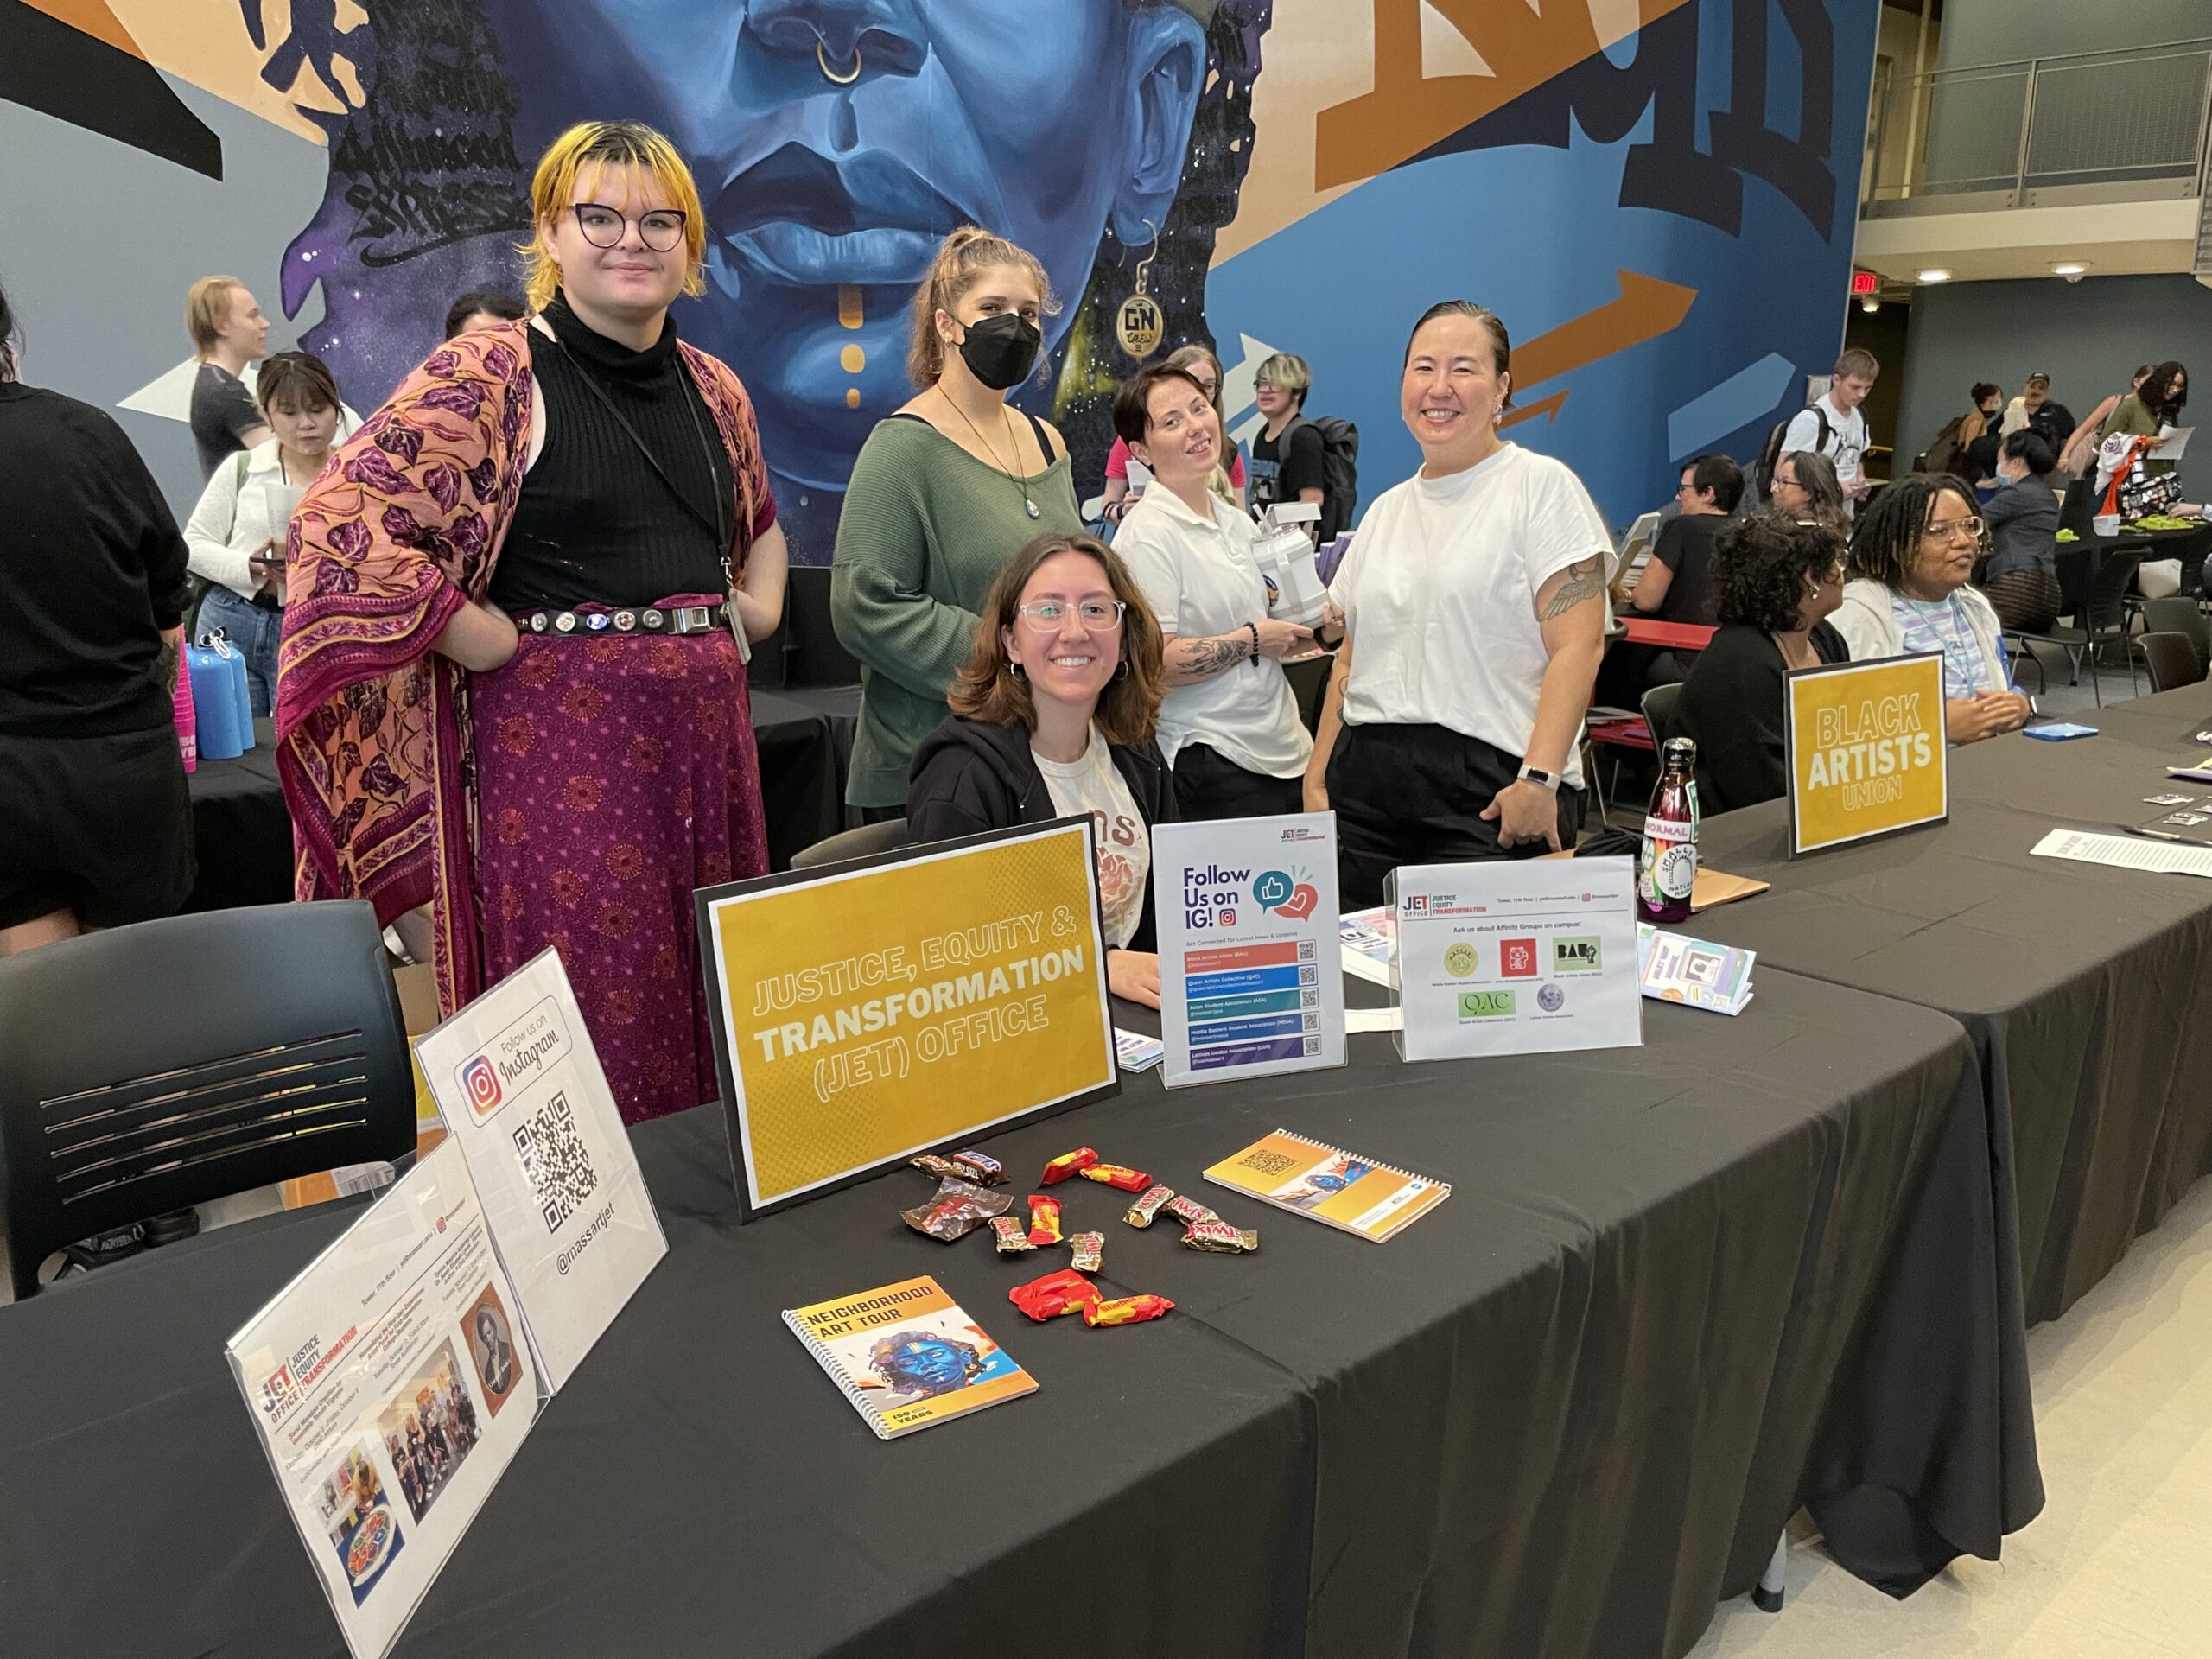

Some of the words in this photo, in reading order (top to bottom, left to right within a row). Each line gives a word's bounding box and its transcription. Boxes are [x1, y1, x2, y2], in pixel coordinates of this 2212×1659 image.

[1854, 276, 1876, 292] EXIT
[1125, 308, 1154, 331] GN
[1817, 693, 1921, 748] BLACK
[1808, 733, 1932, 791] ARTISTS
[1842, 775, 1902, 811] UNION
[1645, 823, 1688, 836] NORMAL
[1184, 864, 1250, 887] Follow
[1185, 888, 1209, 908] Us
[1213, 892, 1239, 906] on
[1402, 895, 1428, 911] JET
[1433, 906, 1487, 915] TRANSFORMATION
[1185, 907, 1213, 929] IG!
[1520, 922, 1543, 931] Groups
[753, 946, 918, 1017] JUSTICE,
[921, 911, 1044, 973] EQUITY
[1051, 906, 1077, 937] &
[1558, 944, 1588, 958] BAU
[753, 945, 1084, 1063] TRANSFORMATION
[1465, 992, 1510, 1015] QAC
[501, 1030, 526, 1055] Follow
[526, 1023, 537, 1036] us
[536, 1015, 548, 1028] on
[499, 1029, 560, 1086] Instagram
[814, 1036, 910, 1103] (JET)
[916, 994, 1049, 1064] OFFICE
[1171, 1198, 1207, 1219] TWIX
[556, 1200, 615, 1276] @massartjet
[1195, 1224, 1239, 1239] TWIX
[807, 1286, 934, 1325] NEIGHBORHOOD
[820, 1320, 854, 1338] ART
[855, 1308, 903, 1327] TOUR
[301, 1324, 358, 1389] TRANSFORMATION
[257, 1363, 294, 1416] JET
[290, 1333, 320, 1369] JUSTICE
[270, 1389, 299, 1425] OFFICE
[296, 1347, 321, 1380] EQUITY
[896, 1410, 933, 1424] YEARS
